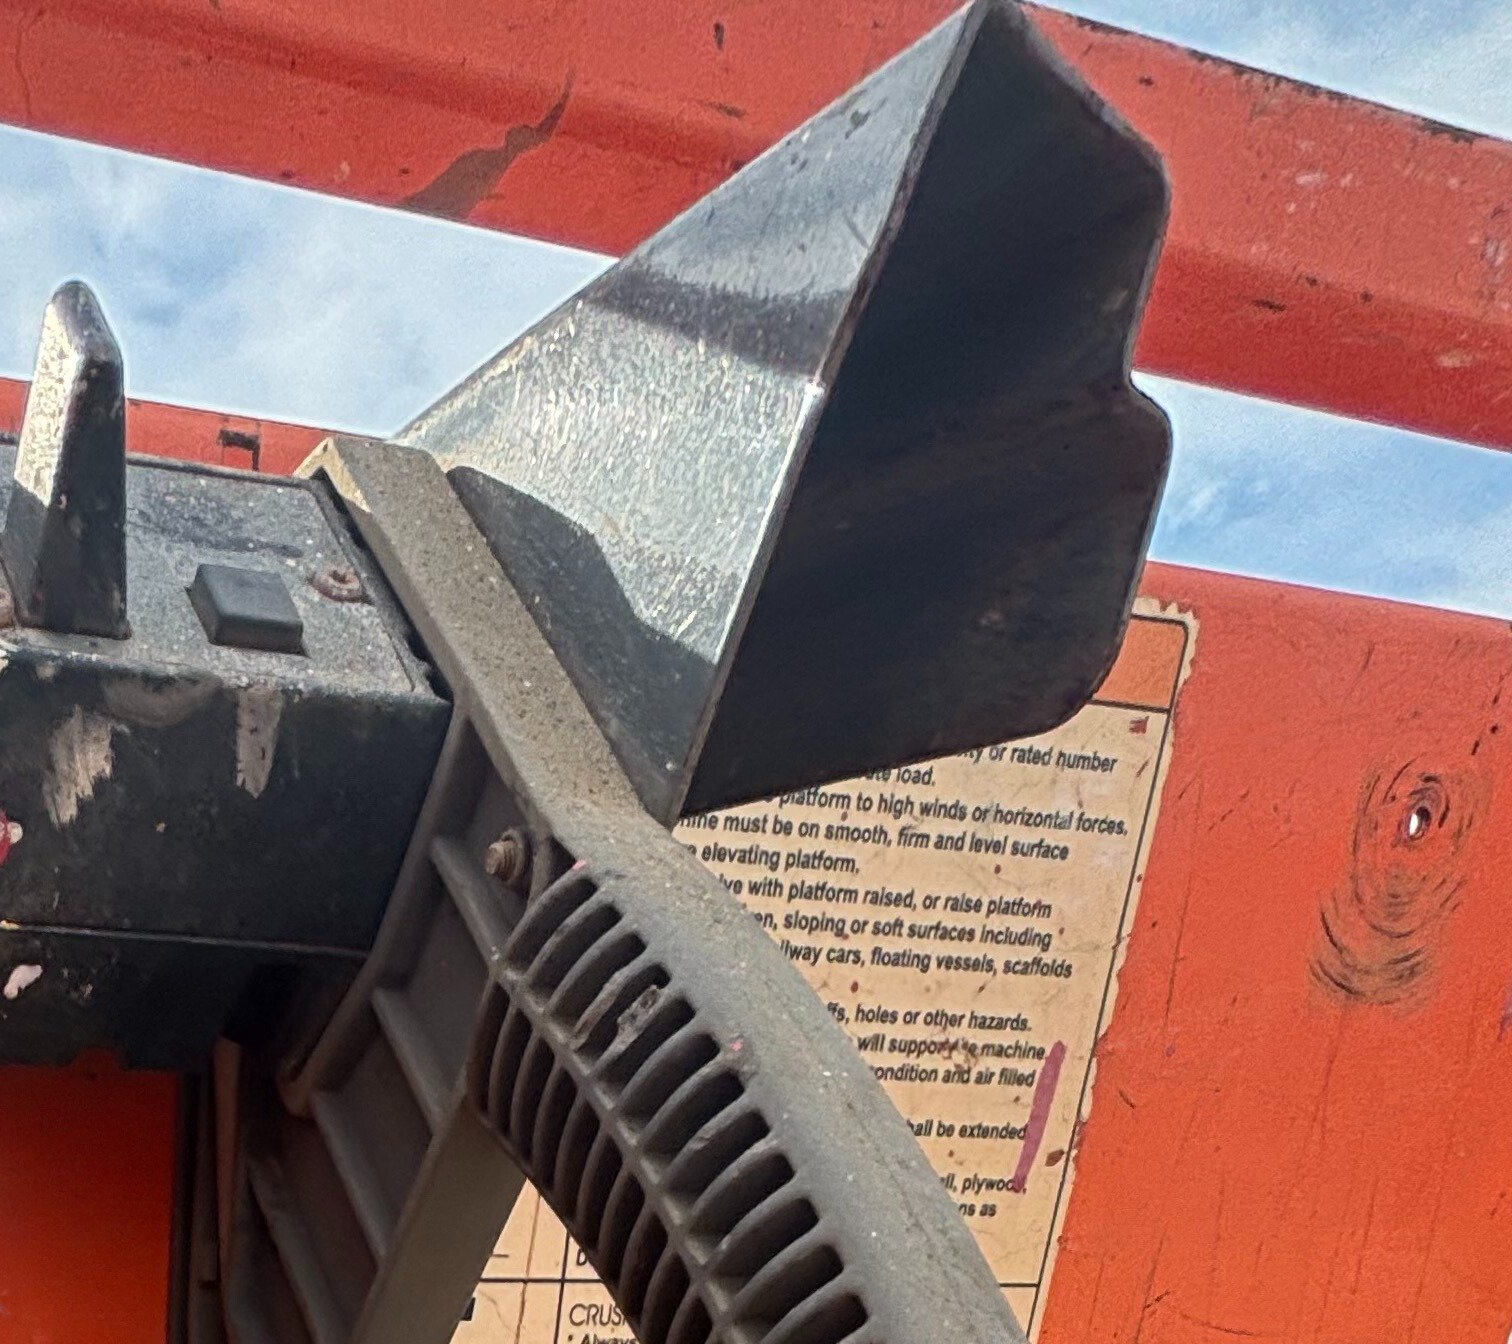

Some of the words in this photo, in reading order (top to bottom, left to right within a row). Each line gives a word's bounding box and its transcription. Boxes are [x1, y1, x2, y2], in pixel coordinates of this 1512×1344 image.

[1010, 743, 1053, 767] rated
[1055, 750, 1118, 774] number
[856, 792, 873, 812] to
[877, 793, 914, 821] high
[919, 799, 967, 821] winds
[971, 804, 991, 822] or
[992, 801, 1074, 830] horizontal
[723, 812, 769, 834] must
[772, 815, 793, 836] be
[797, 820, 820, 838] on
[824, 823, 893, 848] smooth,
[897, 823, 931, 847] firm
[934, 828, 966, 850] and
[968, 830, 1008, 855] level
[1010, 838, 1070, 862] surface
[700, 841, 781, 873] elevating
[747, 875, 784, 898] with
[786, 878, 859, 905] platform
[862, 886, 917, 911] raised,
[921, 894, 941, 910] or
[942, 892, 984, 914] raise
[985, 895, 1053, 919] platform
[783, 908, 846, 938] sloping
[850, 918, 870, 935] or
[871, 915, 905, 938] soft
[906, 920, 976, 943] surfaces
[979, 923, 1053, 953] including
[825, 947, 866, 968] cars,
[870, 945, 932, 974] floating
[935, 952, 998, 977] vessels,
[1001, 956, 1074, 980] scaffolds
[854, 1002, 899, 1024] holes
[902, 1009, 922, 1026] or
[923, 1008, 966, 1031] other
[967, 1010, 1033, 1032] hazards.
[856, 1033, 886, 1054] will
[980, 1040, 1047, 1062] machine
[941, 1066, 971, 1086] and
[974, 1066, 997, 1086] air
[997, 1066, 1038, 1088] filled
[937, 1119, 956, 1138] be
[958, 1121, 1030, 1141] extended
[978, 1202, 998, 1217] as
